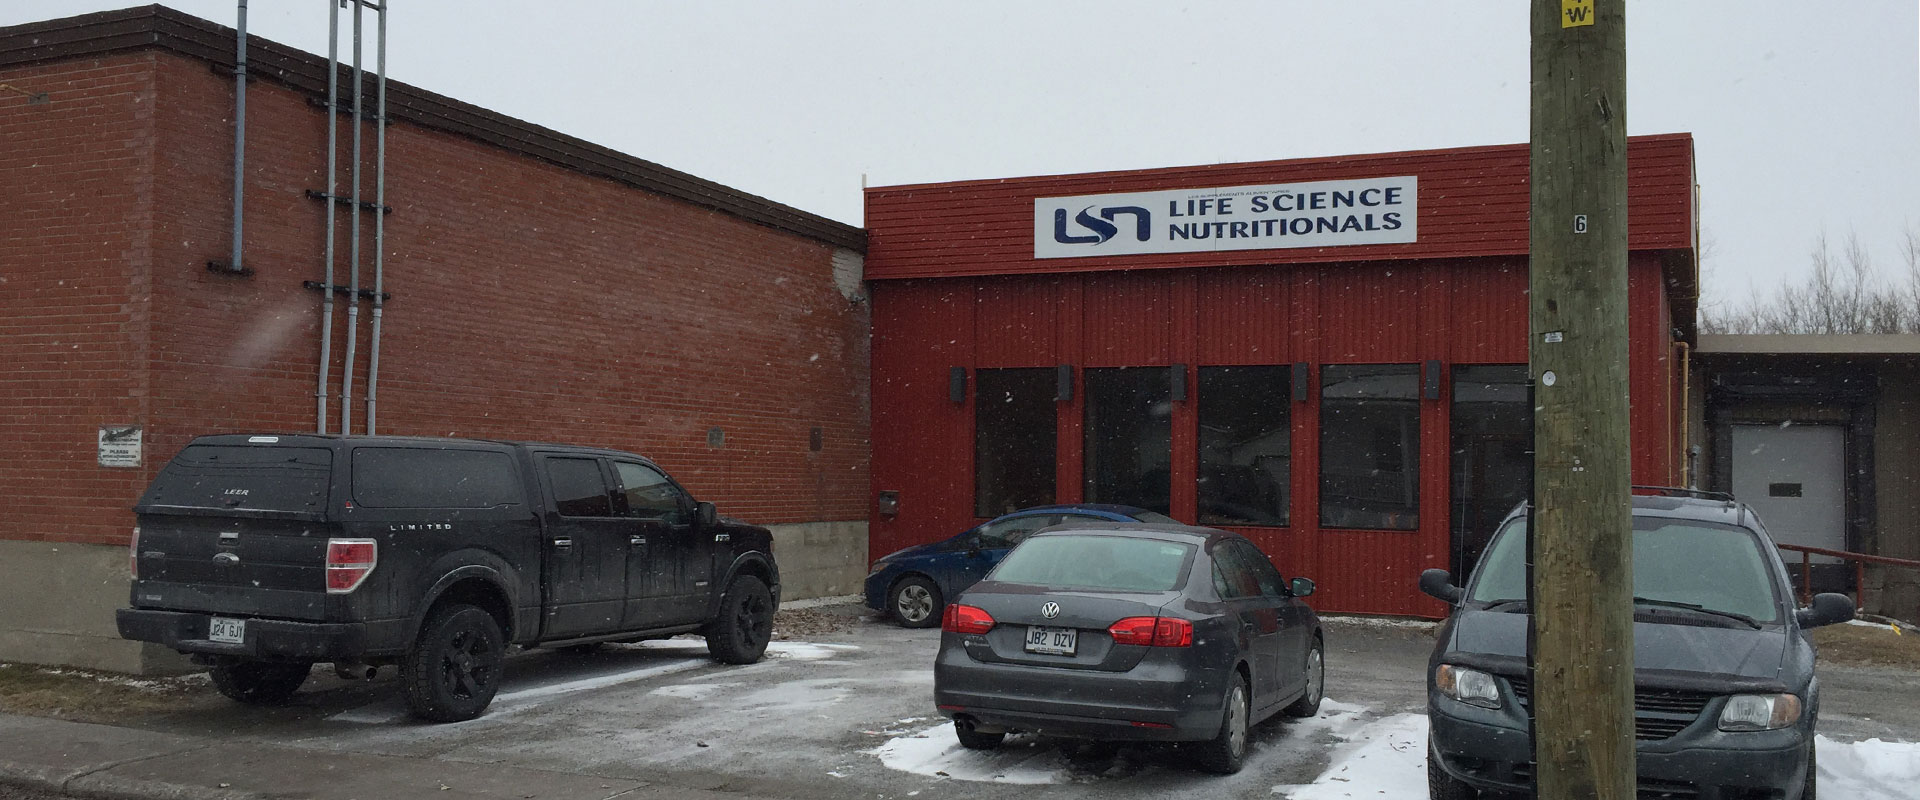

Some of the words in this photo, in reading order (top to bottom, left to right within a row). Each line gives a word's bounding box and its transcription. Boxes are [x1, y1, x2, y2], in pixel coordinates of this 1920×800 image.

[1169, 197, 1233, 218] LIFE
[1251, 187, 1403, 213] SCIENCE
[1169, 212, 1402, 241] NUTRITIONALS
[1576, 216, 1586, 232] 6
[390, 523, 452, 531] LIMITED
[211, 624, 225, 636] J24
[1027, 631, 1048, 645] J82
[1053, 633, 1075, 648] DZV
